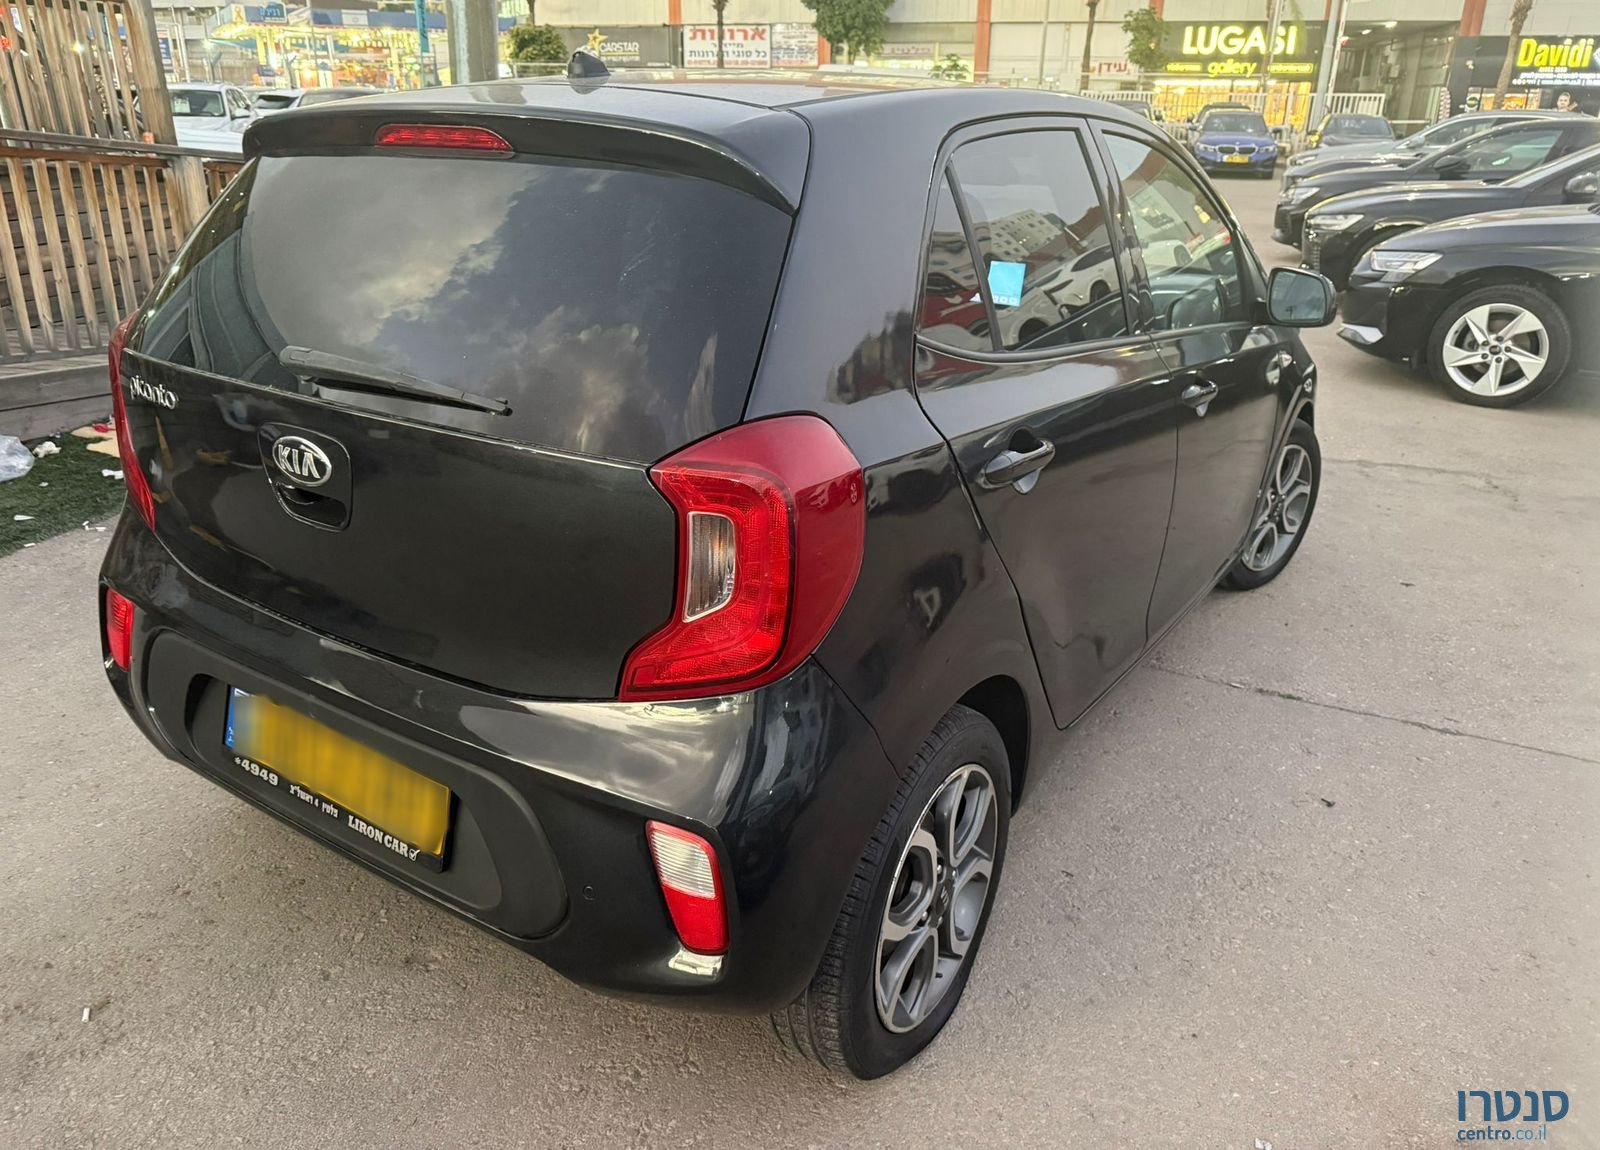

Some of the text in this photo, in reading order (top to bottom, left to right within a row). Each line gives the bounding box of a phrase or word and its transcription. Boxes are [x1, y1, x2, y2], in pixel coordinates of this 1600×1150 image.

[599, 42, 640, 52] CARSTAR
[755, 48, 767, 58] כל
[1182, 25, 1298, 55] LUGASI
[1516, 38, 1595, 68] Davidi
[1207, 58, 1257, 78] gallery
[130, 375, 179, 410] picanto
[277, 444, 321, 479] KIA
[348, 814, 409, 858] LIRON CAR
